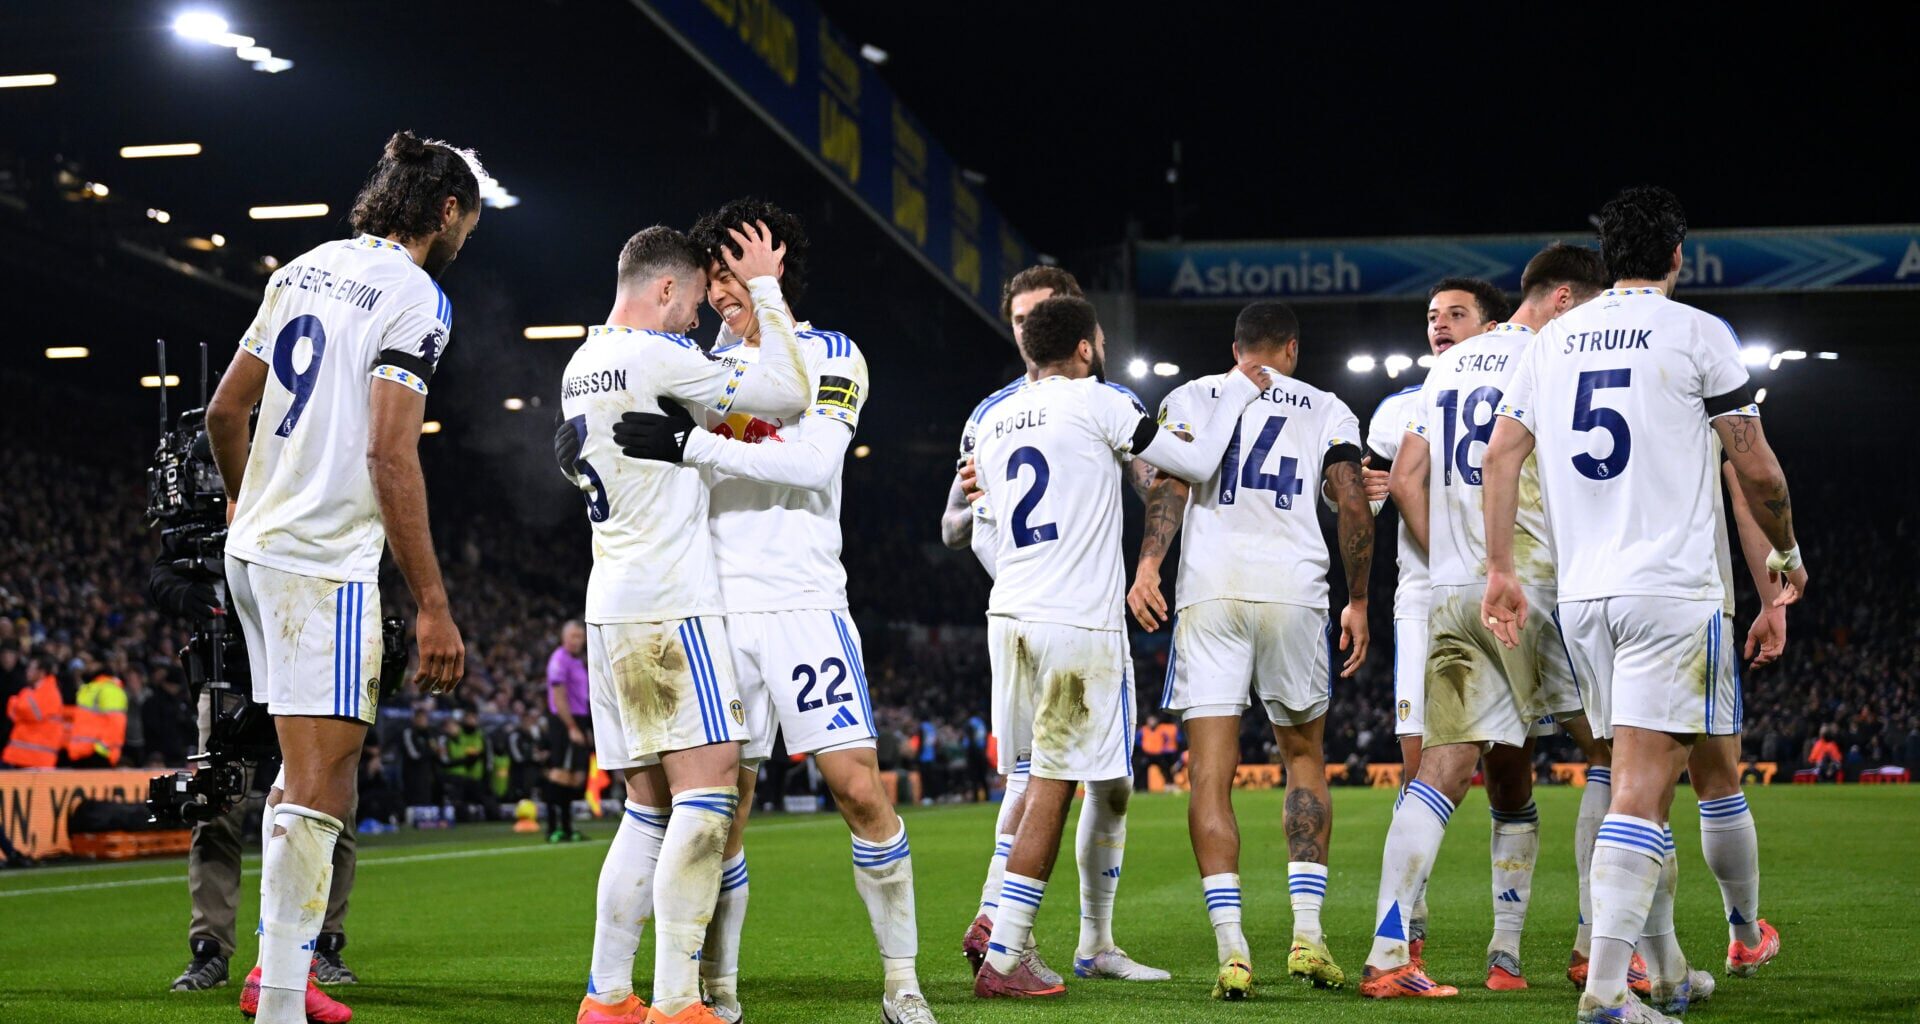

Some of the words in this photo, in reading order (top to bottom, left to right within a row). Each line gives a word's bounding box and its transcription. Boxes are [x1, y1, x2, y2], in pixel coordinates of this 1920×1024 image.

[1171, 250, 1360, 295] Astonish
[272, 313, 327, 439] 9
[1455, 353, 1508, 373] STACH
[1564, 328, 1653, 355] STRUIJK
[995, 407, 1048, 440] BOGLE
[1436, 385, 1504, 487] 18
[1571, 367, 1632, 481] 5
[1006, 445, 1059, 549] 2
[1218, 415, 1304, 511] 14
[791, 657, 854, 713] 22
